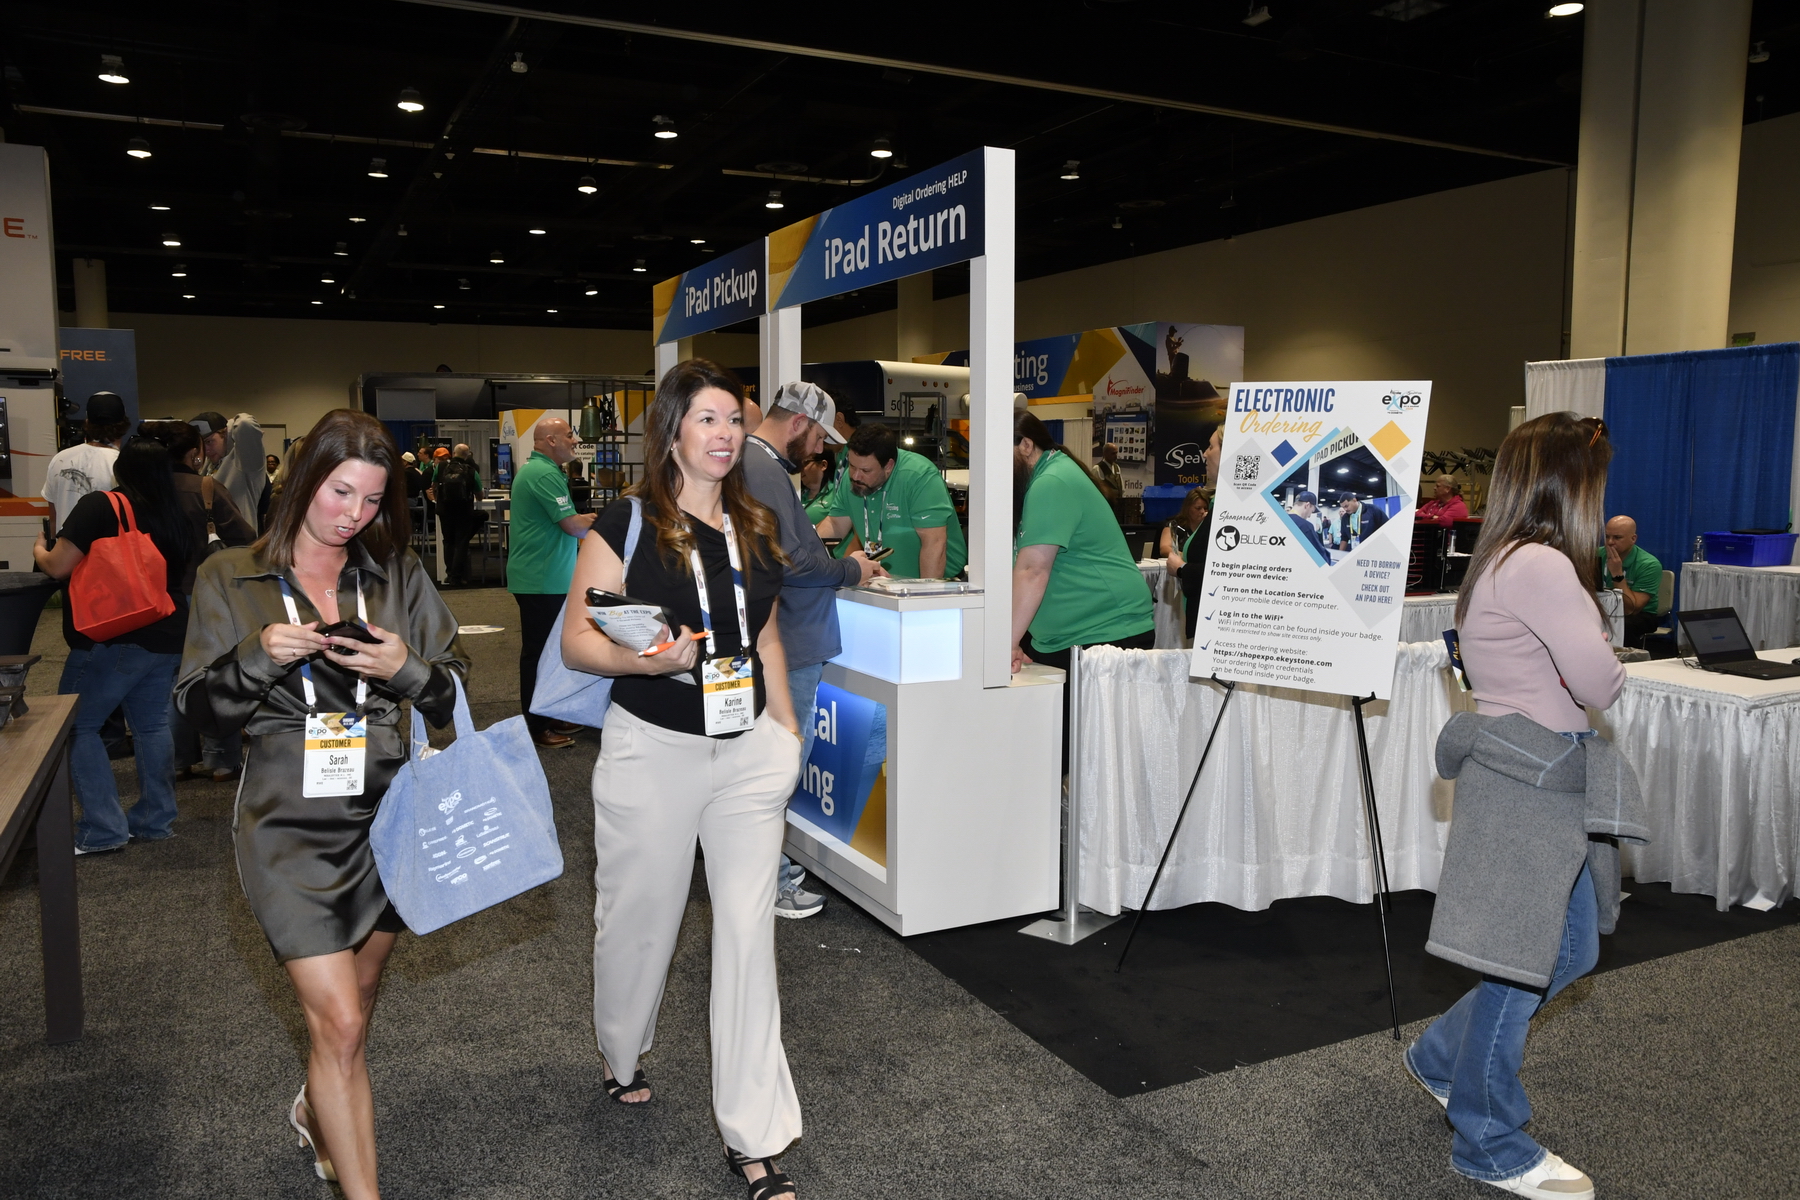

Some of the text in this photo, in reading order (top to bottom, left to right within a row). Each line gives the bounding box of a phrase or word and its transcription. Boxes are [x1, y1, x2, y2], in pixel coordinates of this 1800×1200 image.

[892, 169, 968, 210] Digital Ordering HELP
[824, 203, 966, 280] iPad Return
[685, 268, 758, 318] iPad Pickup
[60, 350, 106, 361] FREE
[1014, 350, 1049, 386] ting
[1014, 382, 1035, 392] usiness
[1109, 386, 1145, 398] MagniFinder
[1234, 387, 1336, 413] ELECTRONIC
[1381, 394, 1422, 410] expo
[1239, 408, 1323, 443] Ordering
[1124, 480, 1143, 490] Finds
[1178, 474, 1199, 484] Tools
[1219, 510, 1269, 525] Sponsored By:
[1240, 534, 1287, 547] BLUE OX
[1221, 562, 1241, 571] begin
[1242, 563, 1268, 572] placing
[1269, 565, 1292, 573] orders
[1356, 559, 1402, 569] NEED TO BORROW
[1210, 569, 1227, 577] from
[1263, 573, 1289, 582] device:
[1363, 570, 1391, 579] A DEVICE?
[1223, 585, 1239, 593] Turn
[1264, 589, 1296, 598] Location
[1297, 591, 1325, 600] Service
[1361, 583, 1390, 593] CHECK OUT
[1247, 595, 1270, 605] mobile
[1271, 598, 1293, 606] device
[1303, 602, 1339, 611] computer.
[1355, 593, 1393, 604] AN IPAD HERE!
[1219, 610, 1232, 618] Log
[1218, 618, 1232, 626] WiFi
[1232, 619, 1272, 630] information
[1286, 624, 1295, 632] be
[1296, 625, 1317, 634] found
[1318, 628, 1340, 637] inside
[1341, 631, 1358, 639] your
[1359, 631, 1383, 642] badge.
[1236, 628, 1260, 636] restricted
[1215, 640, 1308, 656] Access the ordering website:
[1213, 648, 1333, 667] https://shopexpo.ekeystone.com
[1212, 656, 1314, 674] Your ordering login credentials
[1224, 666, 1232, 674] be
[1233, 667, 1253, 676] found
[1254, 669, 1275, 679] inside
[1275, 673, 1292, 681] your
[1292, 673, 1316, 684] badge.
[715, 680, 741, 691] CUSTOMER
[724, 697, 743, 707] Karine
[320, 739, 352, 749] CUSTOMER
[329, 754, 349, 766] Sarah
[803, 762, 835, 817] ing
